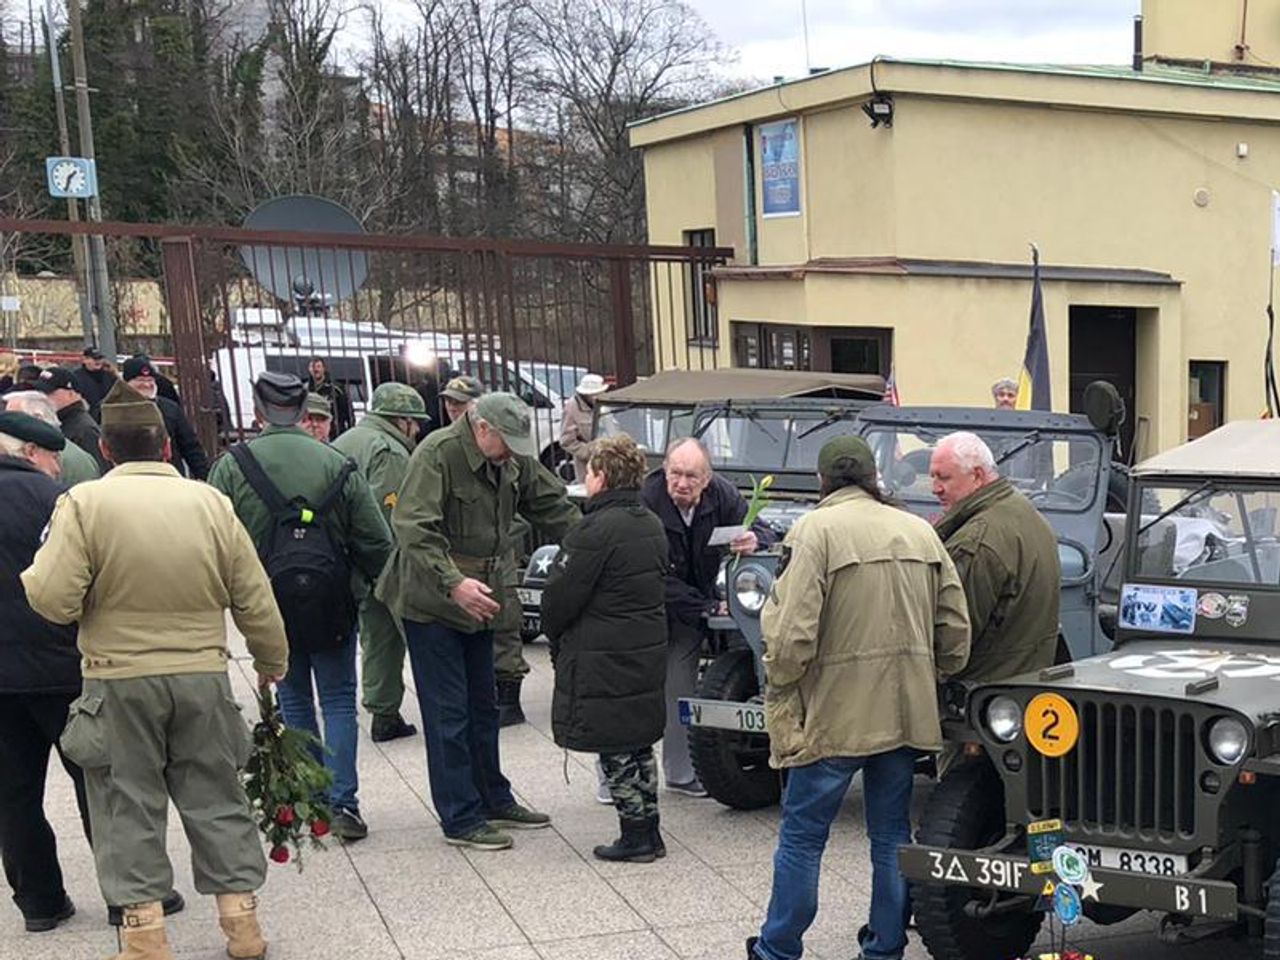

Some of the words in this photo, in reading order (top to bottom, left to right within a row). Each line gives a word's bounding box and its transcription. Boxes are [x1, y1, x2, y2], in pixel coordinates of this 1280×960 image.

[692, 704, 702, 723] V
[736, 708, 766, 731] 103
[1041, 708, 1060, 741] 2
[1119, 851, 1175, 877] 8338
